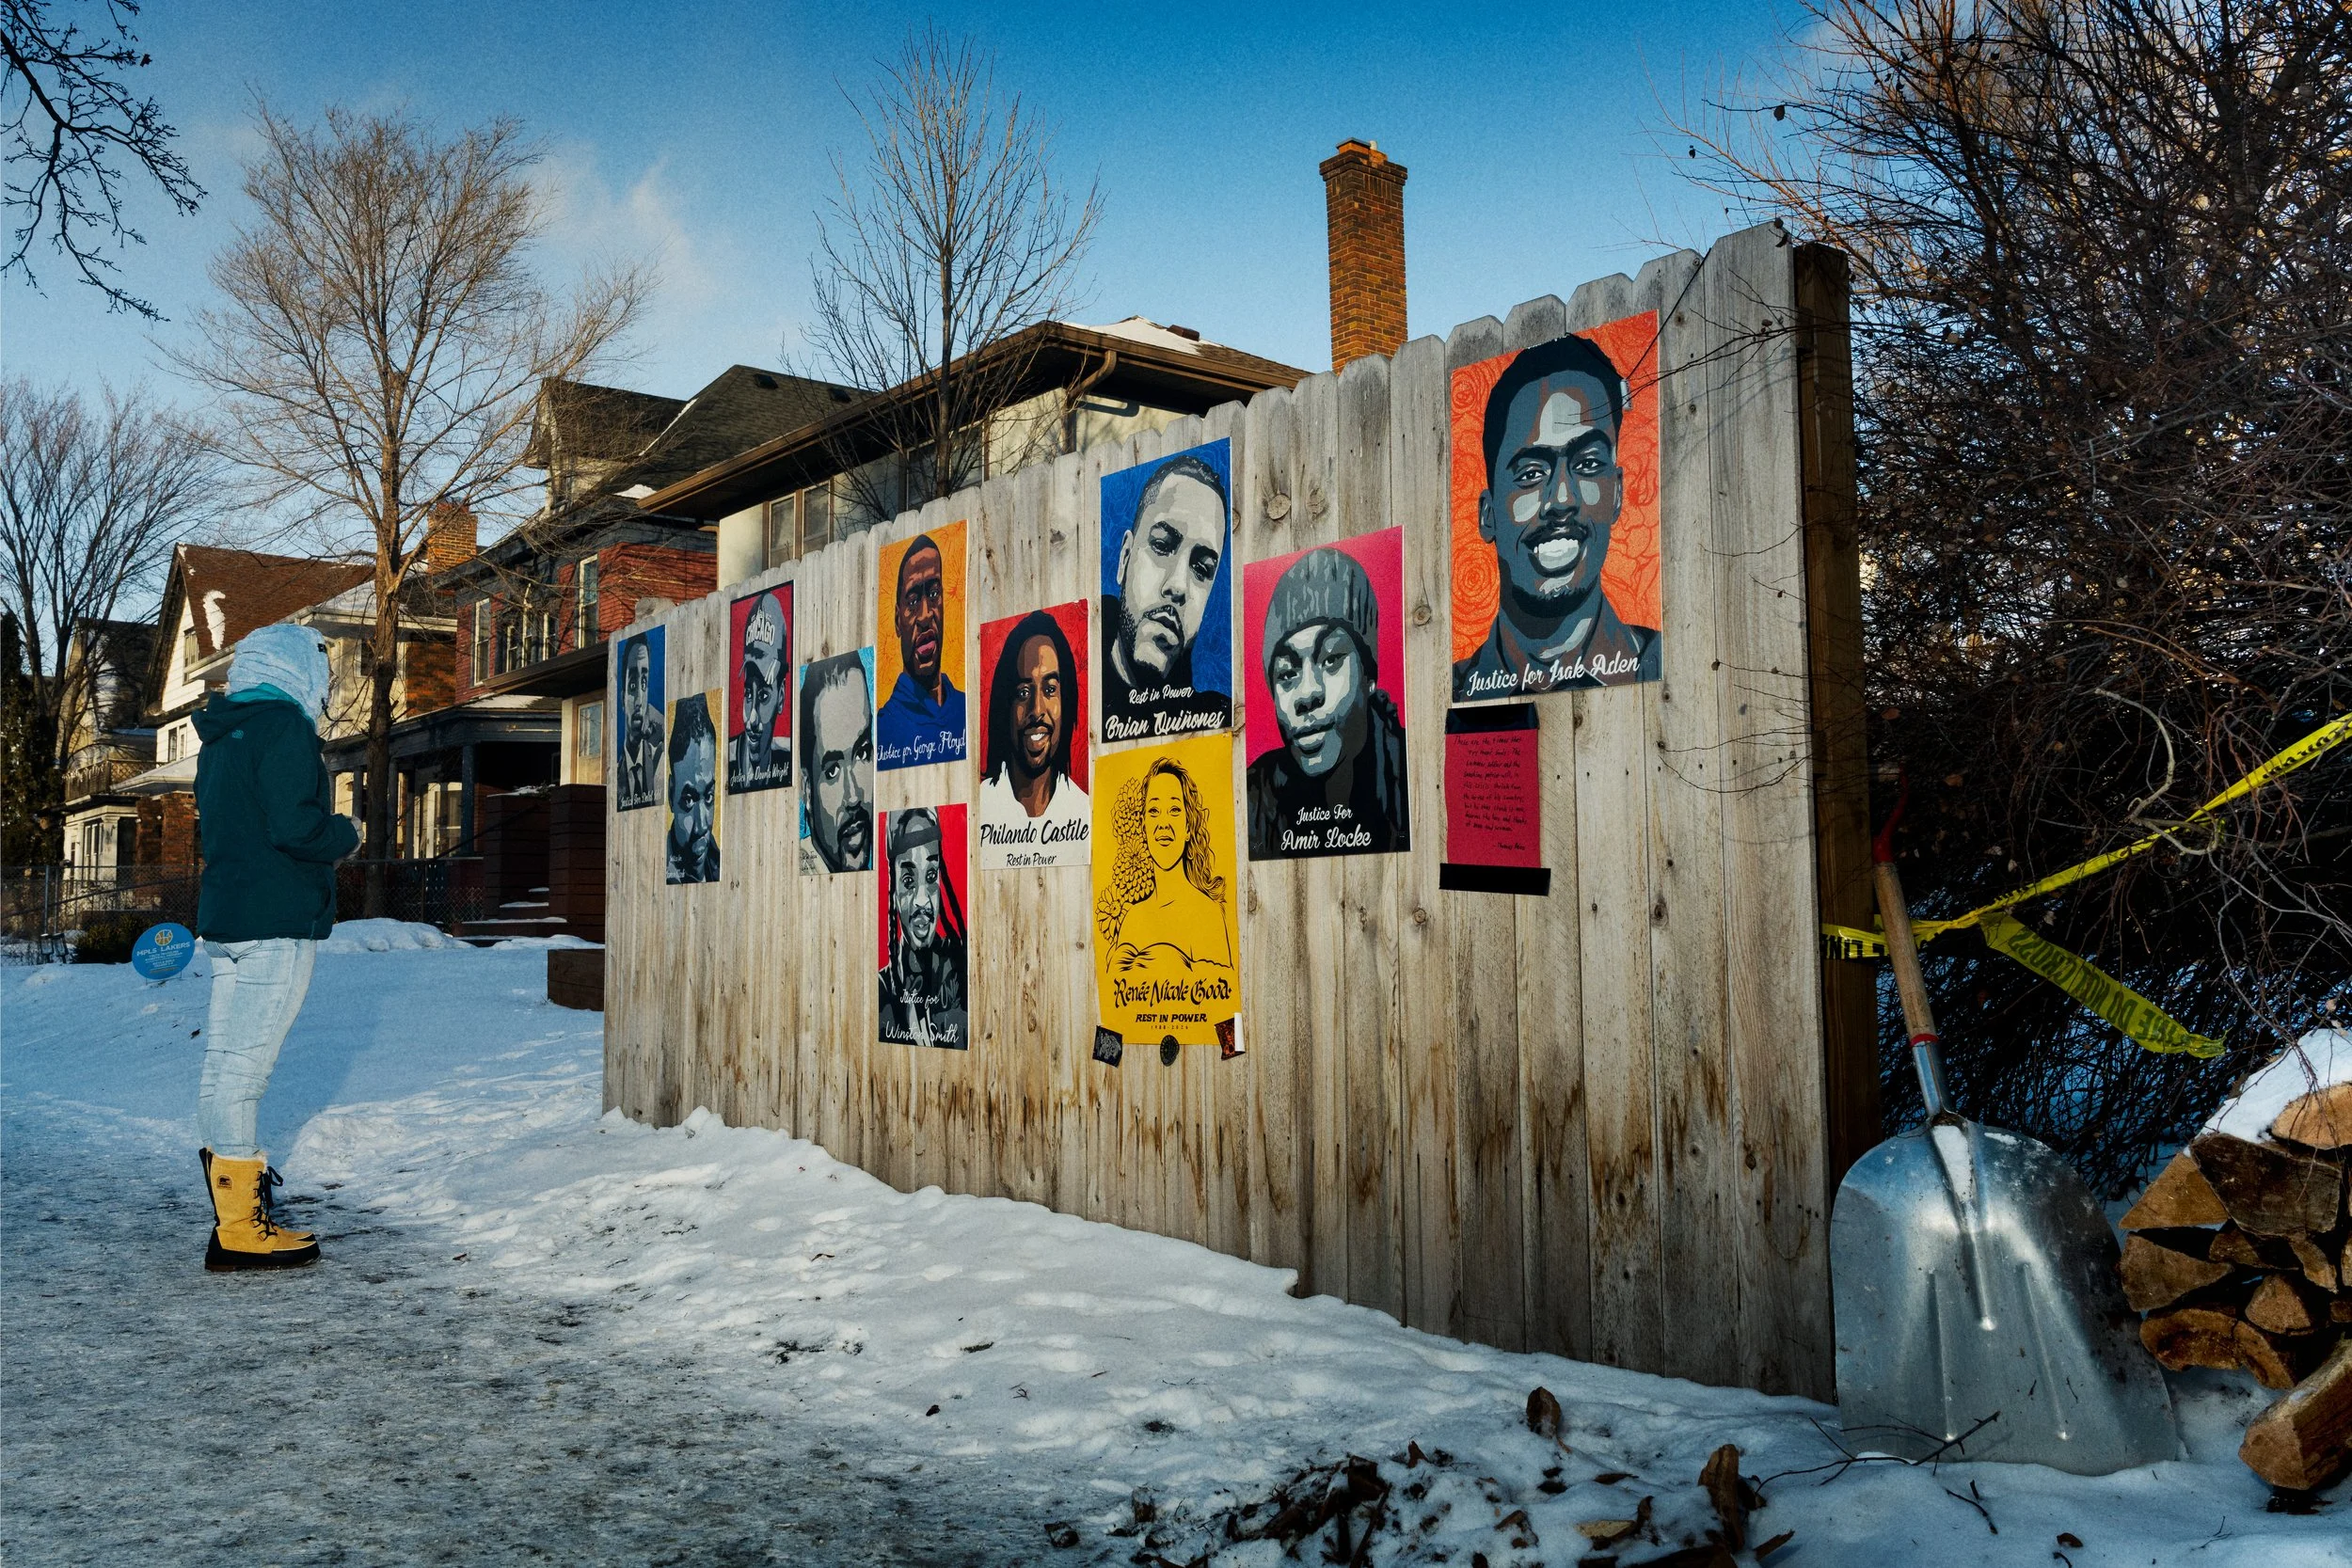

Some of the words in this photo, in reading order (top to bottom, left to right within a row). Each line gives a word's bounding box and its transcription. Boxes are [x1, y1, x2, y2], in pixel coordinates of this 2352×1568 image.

[746, 619, 775, 646] CHICAGO
[1467, 669, 1518, 697] Justice
[1521, 662, 1545, 691] for
[1549, 657, 1586, 684] Isak
[1590, 650, 1641, 676] Aden
[1129, 688, 1149, 705] Rest
[1149, 688, 1160, 702] in
[1162, 684, 1194, 700] Power
[1105, 714, 1150, 739] Brian
[1153, 709, 1226, 736] Quiñones
[877, 742, 901, 762] Justice
[902, 746, 913, 764] for
[914, 735, 937, 761] George
[938, 728, 966, 755] Floyd
[1295, 806, 1331, 825] Justice
[1333, 803, 1353, 820] For
[979, 821, 1038, 847] Philando
[1040, 817, 1089, 845] Castile
[1280, 829, 1321, 851] Amir
[1325, 823, 1373, 848] Locke
[1006, 853, 1024, 867] Rest
[1023, 854, 1032, 866] in
[1032, 852, 1057, 866] Power
[136, 947, 158, 957] MPLS
[160, 942, 191, 952] LAKERS
[900, 988, 924, 1005] Justice
[924, 994, 940, 1009] for
[1150, 978, 1189, 1007] Nicole
[1190, 977, 1232, 1006] Good
[1136, 1013, 1157, 1023] REST
[1159, 1014, 1168, 1023] IN
[1171, 1013, 1208, 1023] POWER
[885, 1021, 925, 1041] Winston
[928, 1022, 960, 1043] Smith
